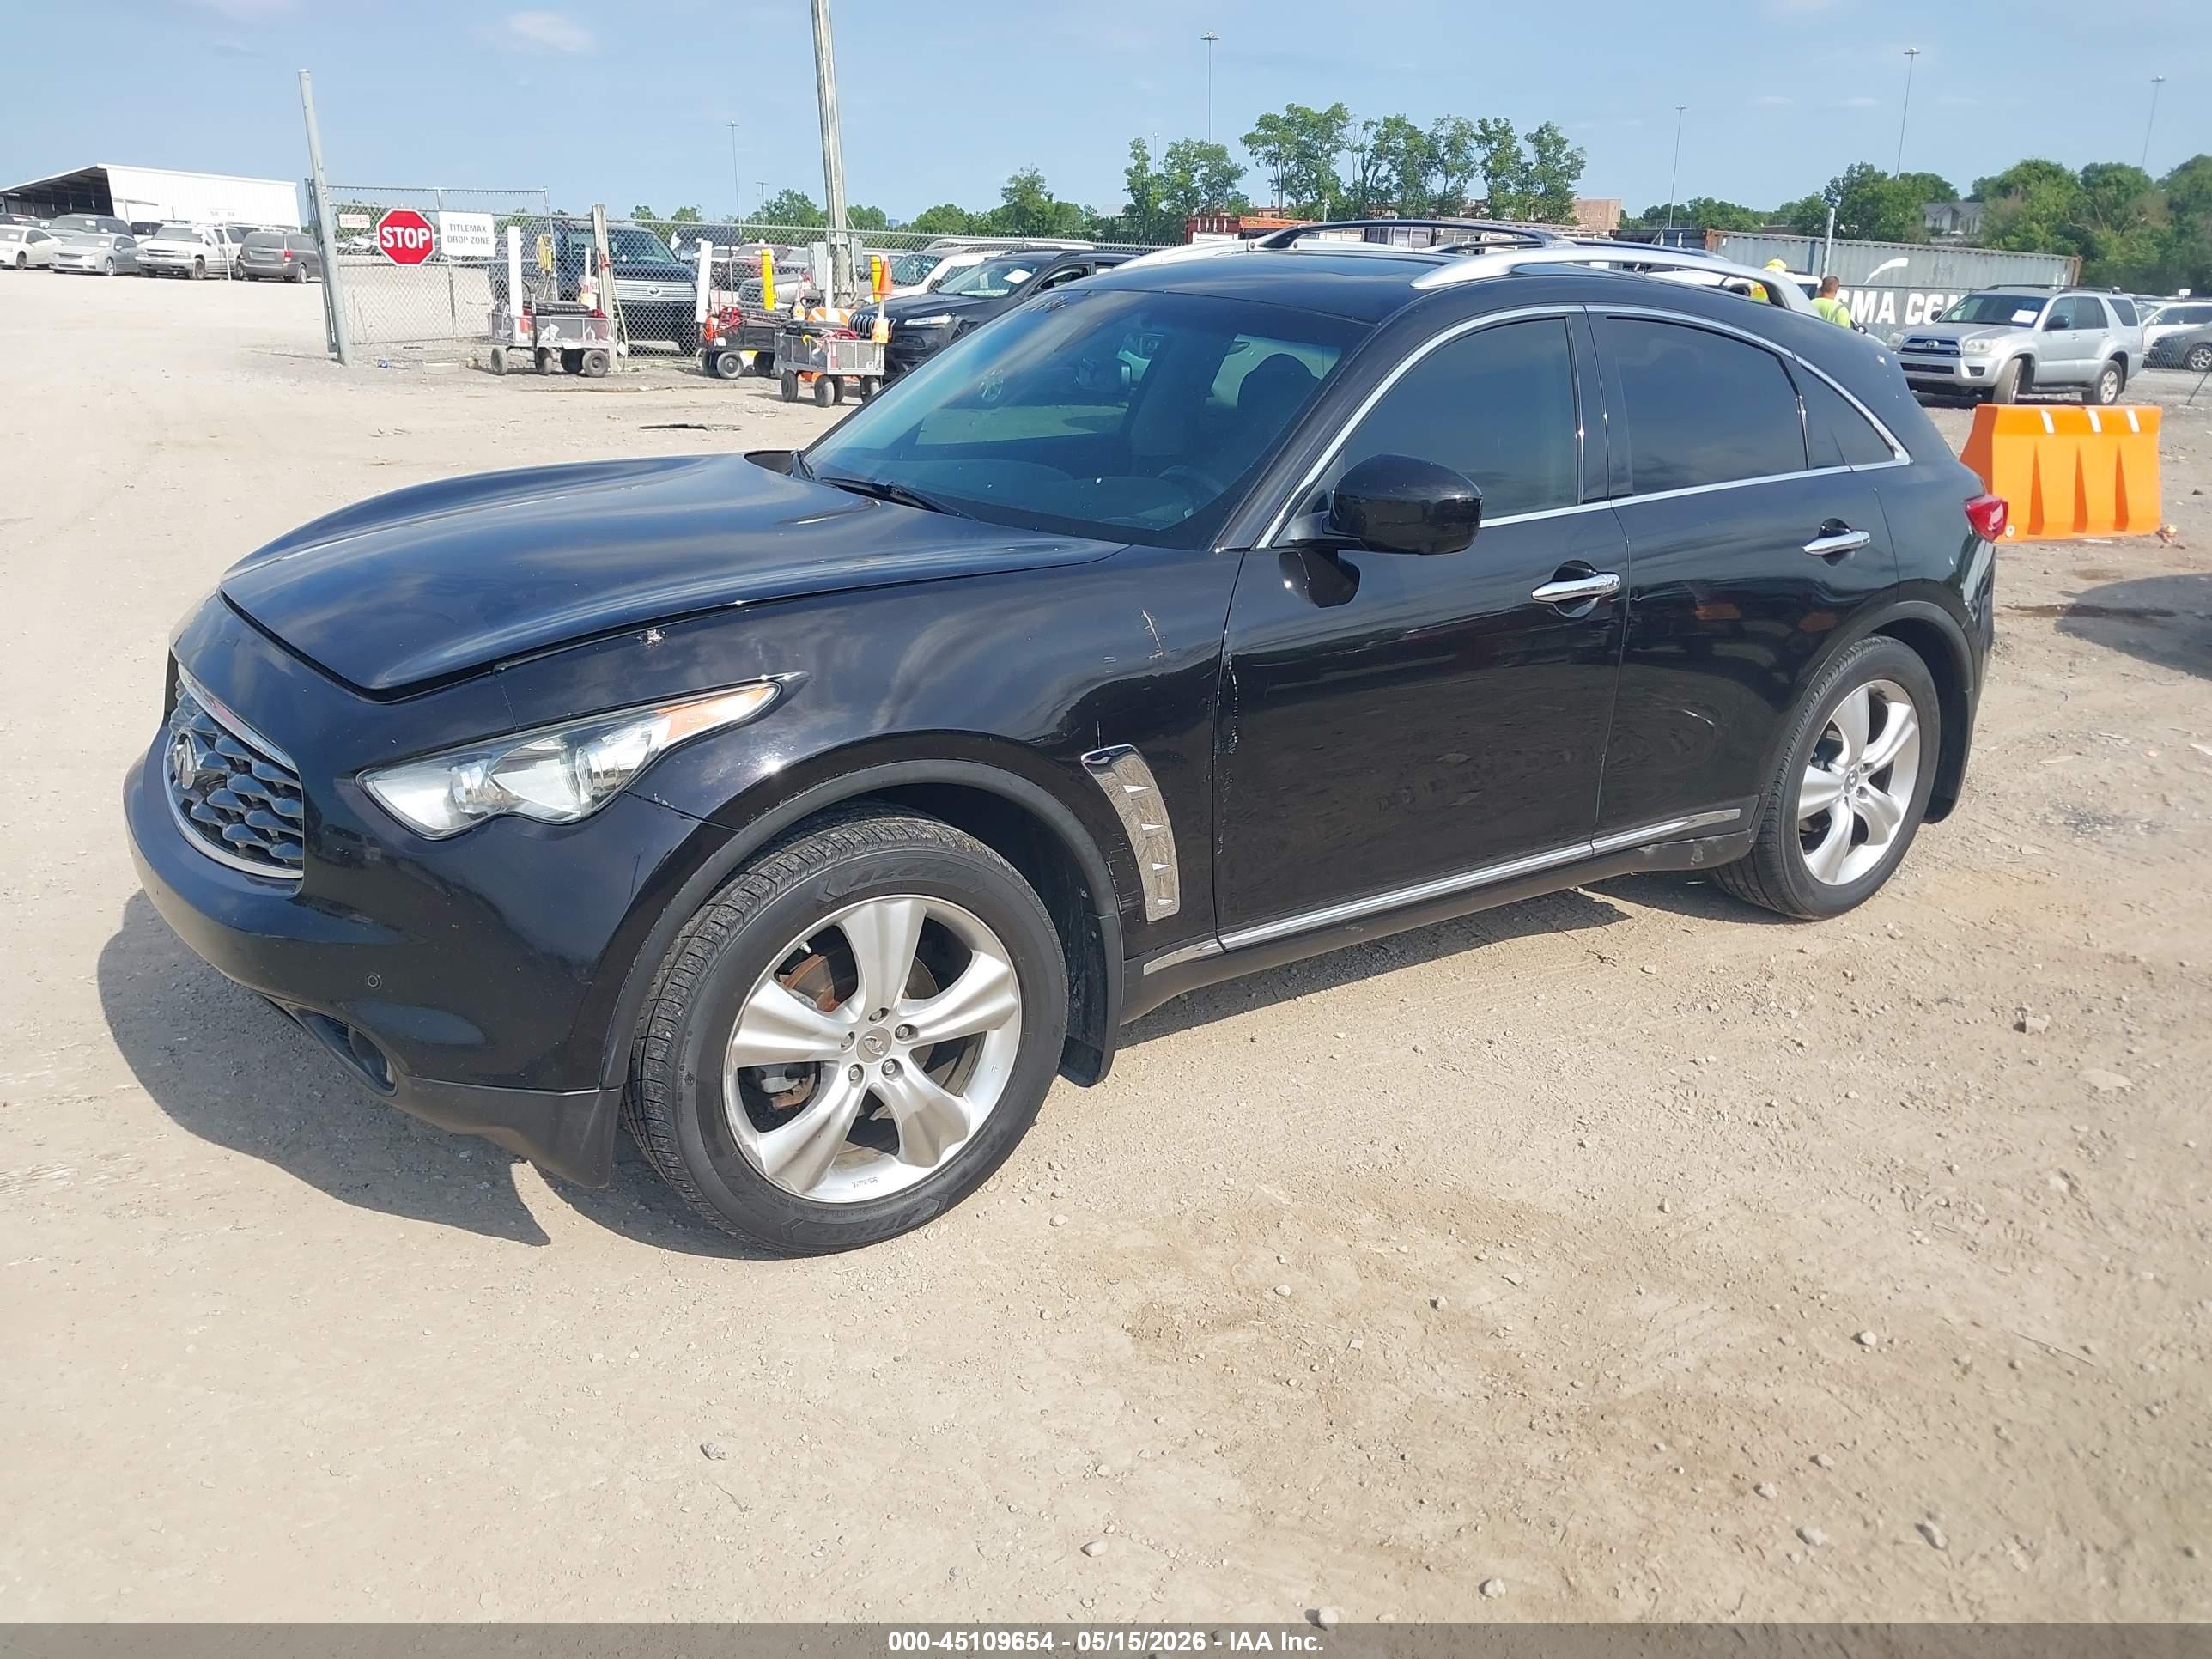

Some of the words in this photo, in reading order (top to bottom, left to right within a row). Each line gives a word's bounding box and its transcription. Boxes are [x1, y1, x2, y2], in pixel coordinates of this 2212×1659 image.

[448, 222, 488, 233] TITLEMAX
[381, 226, 430, 249] STOP
[447, 235, 468, 244] DROP
[471, 236, 491, 245] ZONE
